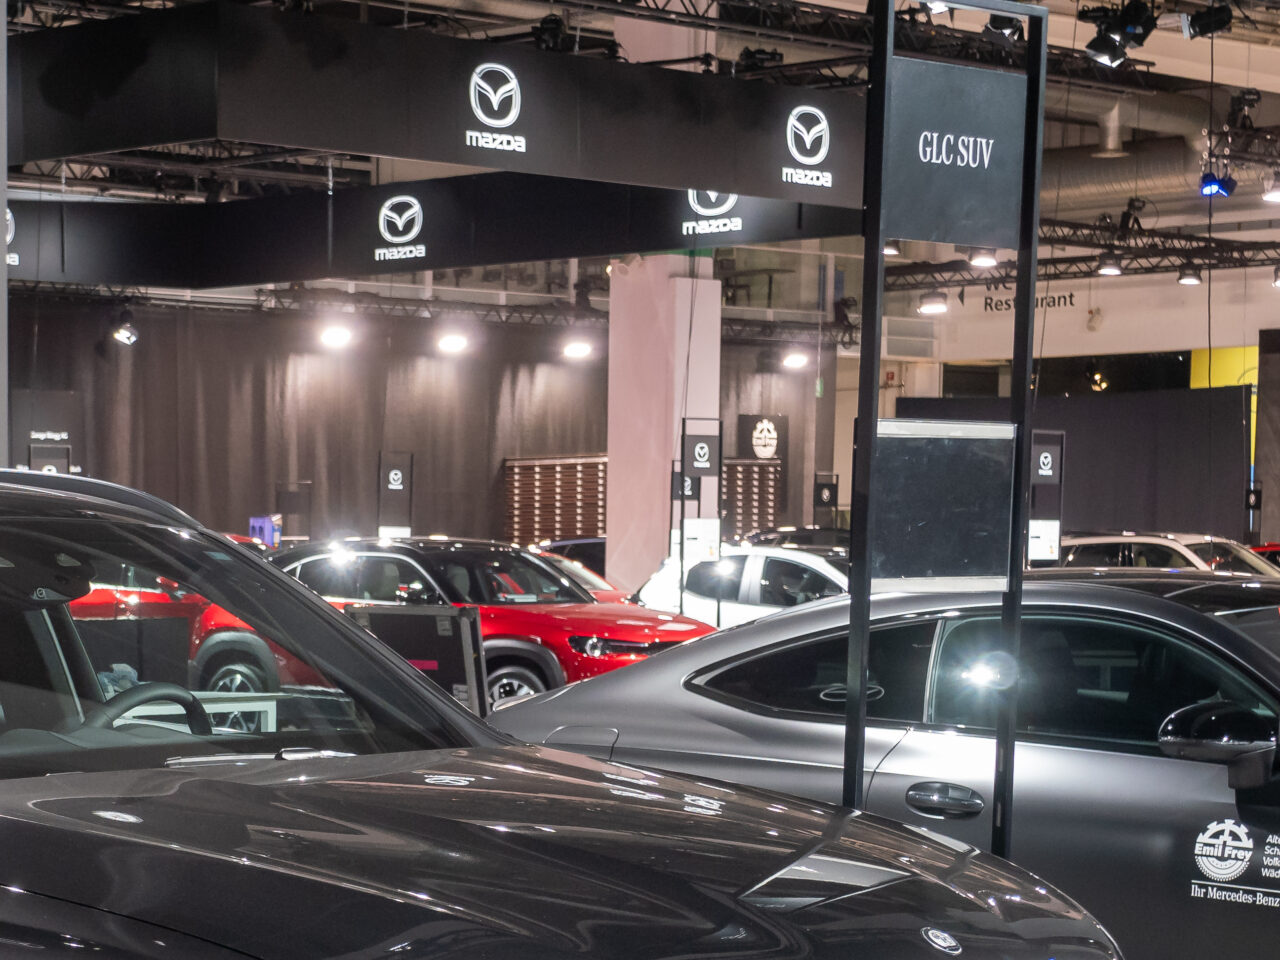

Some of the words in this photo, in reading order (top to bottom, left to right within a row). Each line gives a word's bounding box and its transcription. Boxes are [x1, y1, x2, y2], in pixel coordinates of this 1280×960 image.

[465, 130, 527, 153] mazda
[918, 131, 955, 165] GLC
[957, 135, 995, 170] SUV
[781, 166, 833, 188] mazda
[681, 216, 743, 236] mazda
[374, 244, 427, 261] mazda
[984, 292, 1075, 312] Resrant
[1194, 843, 1222, 857] Emil
[1223, 846, 1253, 862] Frey
[1191, 884, 1206, 898] Ihr
[1207, 886, 1280, 907] Mercedes-Benz
